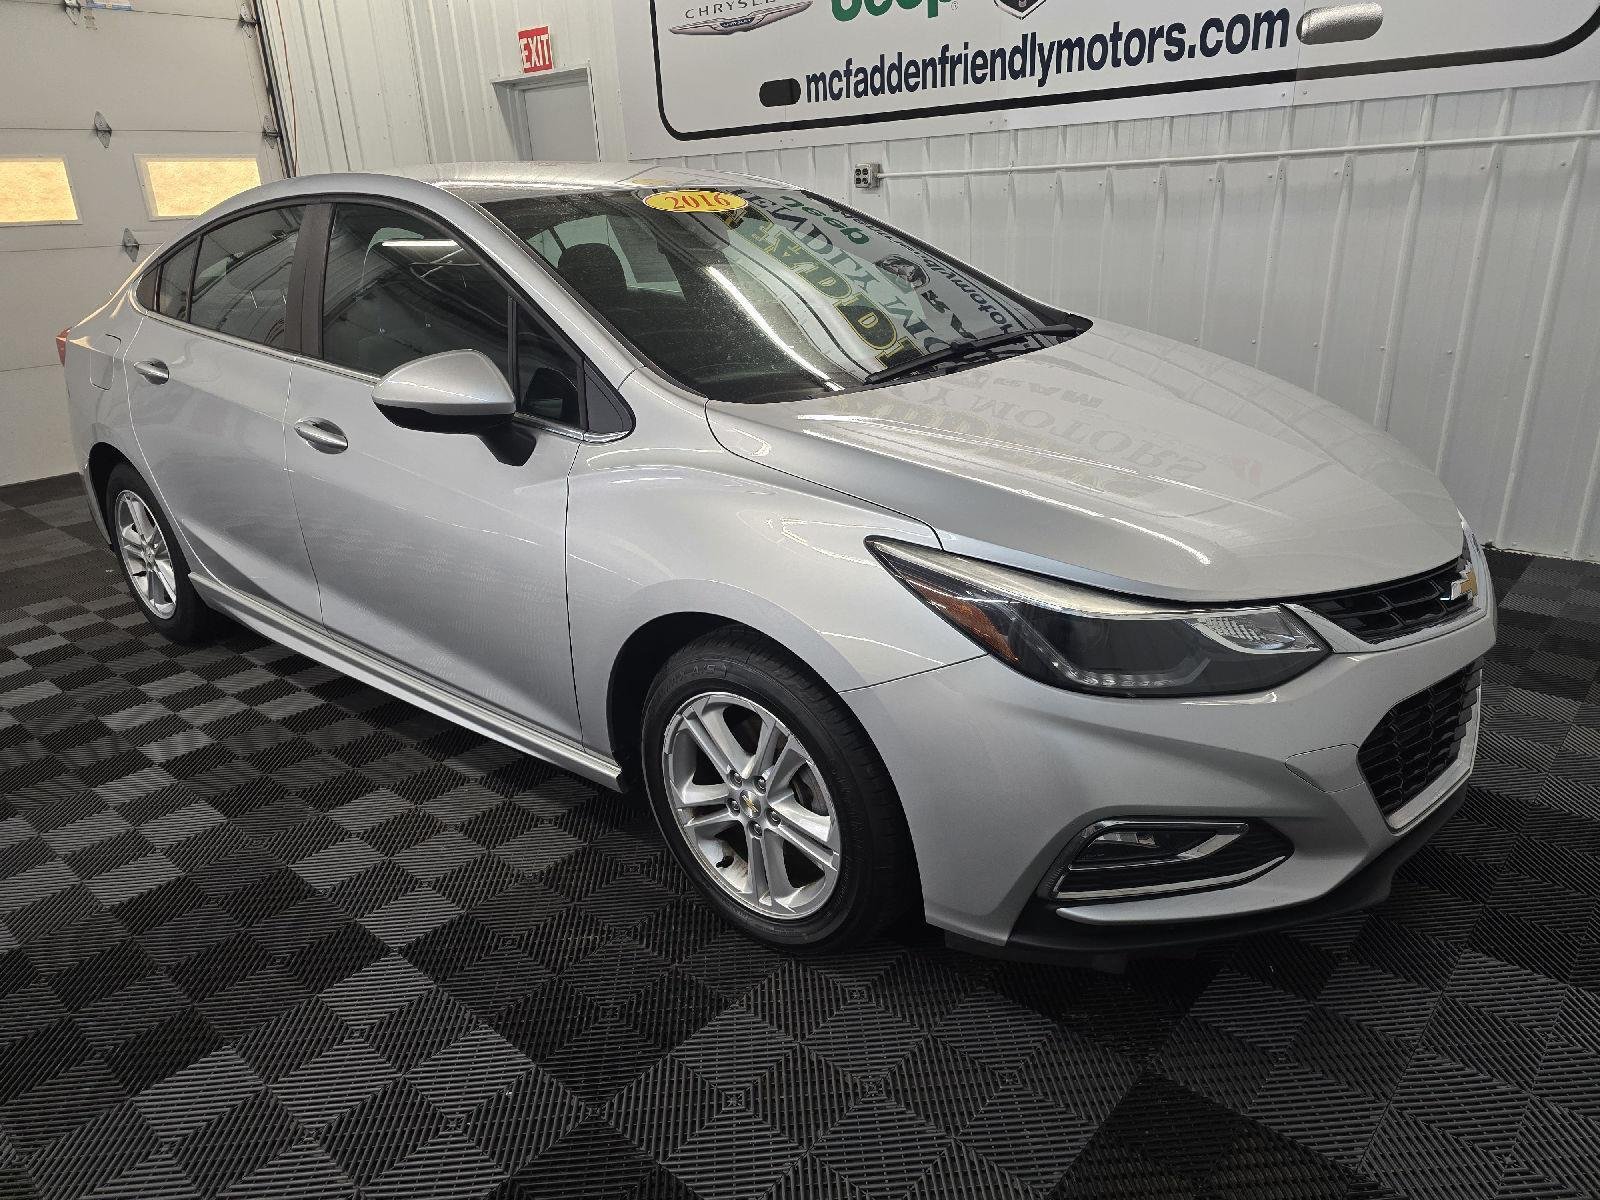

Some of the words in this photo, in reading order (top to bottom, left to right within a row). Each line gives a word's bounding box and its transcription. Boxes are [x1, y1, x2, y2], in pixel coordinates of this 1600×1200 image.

[520, 33, 550, 68] EXIT
[805, 7, 1290, 103] mcfaddenfriendlymotors.com
[664, 192, 731, 210] 2016
